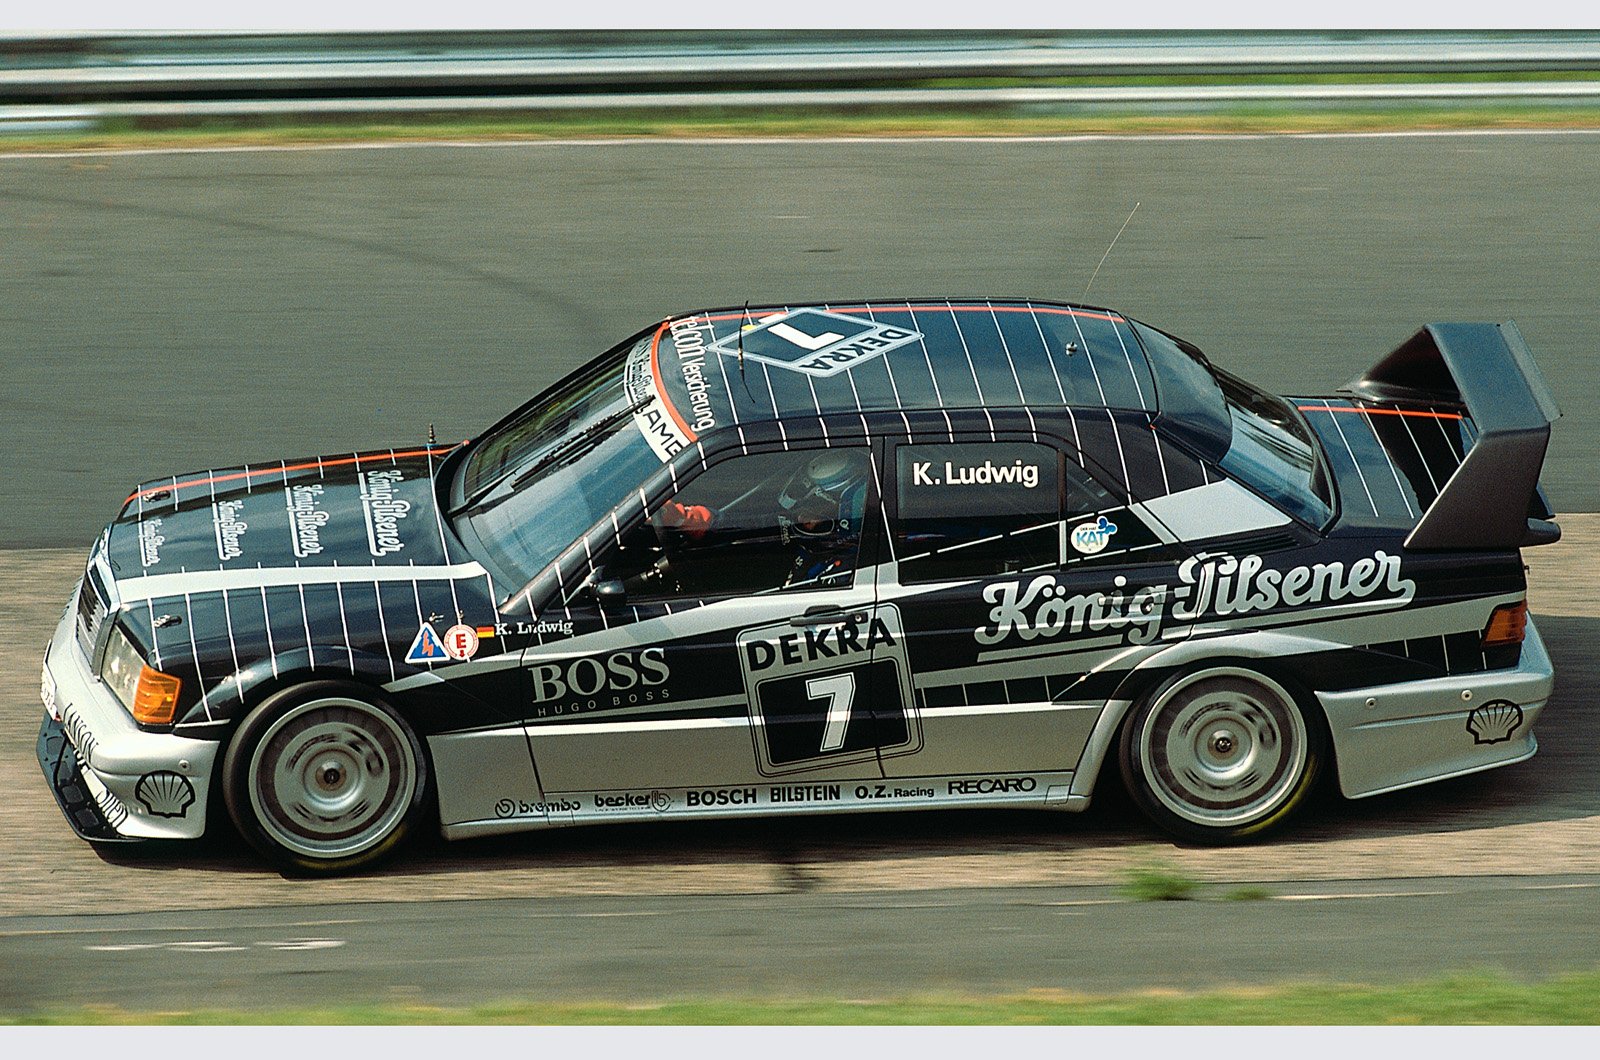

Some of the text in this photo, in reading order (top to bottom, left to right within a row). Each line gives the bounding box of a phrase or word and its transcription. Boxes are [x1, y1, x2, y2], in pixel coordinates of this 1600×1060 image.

[799, 328, 912, 371] DEKRA
[682, 357, 716, 432] Versicherung
[913, 460, 1038, 488] K. Ludwig
[1076, 531, 1106, 547] KAT
[974, 550, 1416, 645] König-Pilsener
[494, 622, 573, 635] K. Ludwig
[746, 617, 897, 672] DEKRA
[527, 647, 670, 703] BOSS
[537, 688, 671, 717] HUGO BOSS
[805, 672, 855, 753] 7
[686, 788, 758, 807] BOSCH
[770, 784, 841, 803] BILSTEIN
[855, 785, 935, 800] O.Z. Racing
[948, 777, 1037, 796] RECARO
[518, 799, 582, 814] brembo
[594, 793, 651, 808] becker
